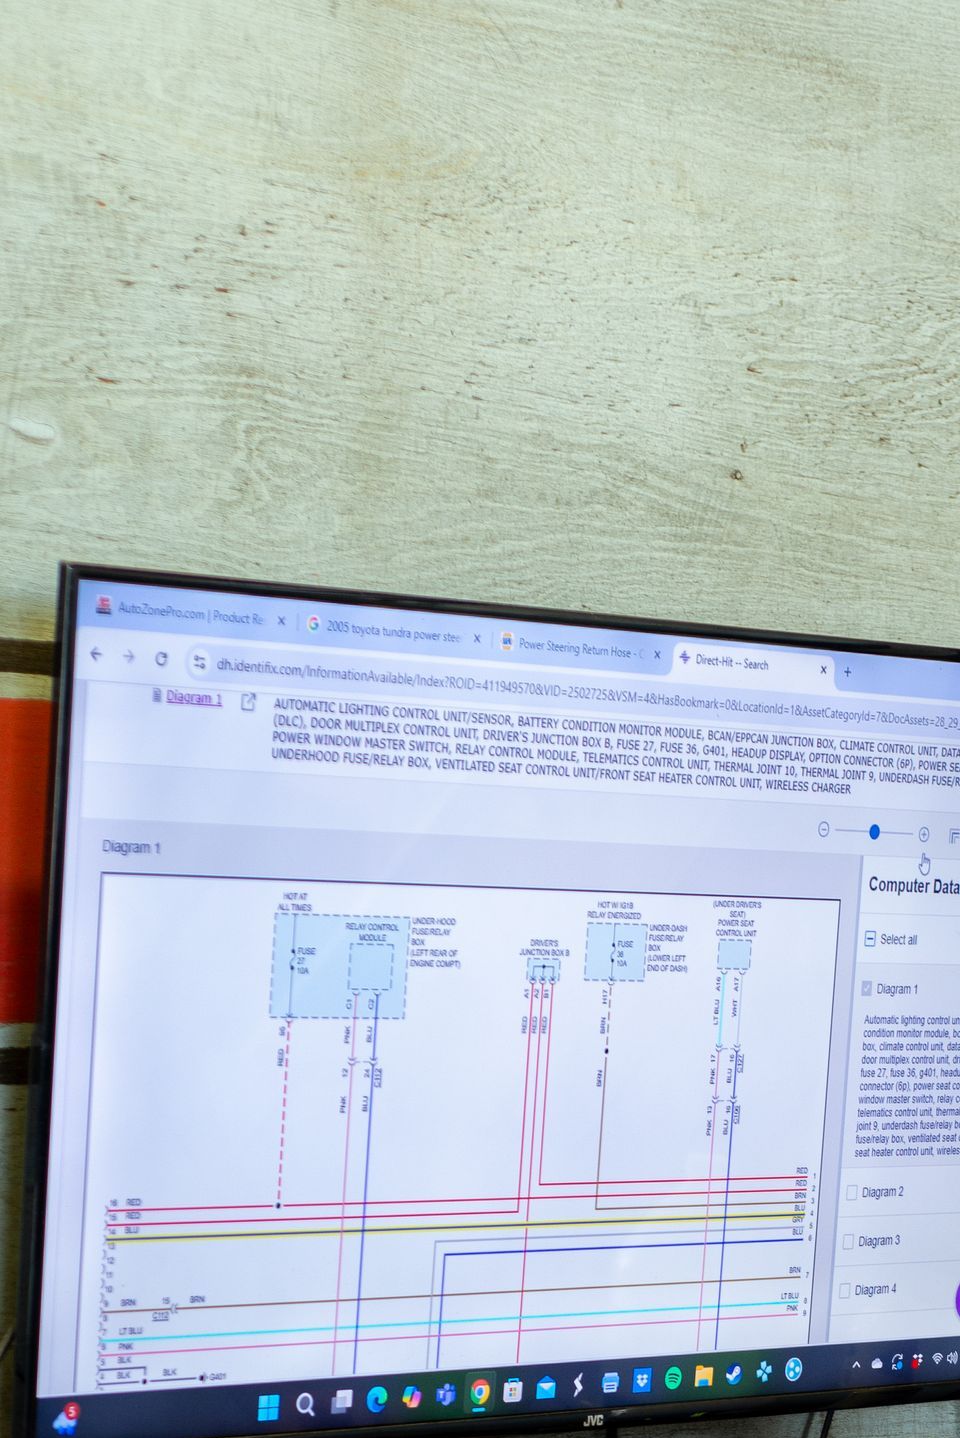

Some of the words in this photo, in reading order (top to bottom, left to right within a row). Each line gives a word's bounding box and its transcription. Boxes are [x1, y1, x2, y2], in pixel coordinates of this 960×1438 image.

[118, 602, 204, 620] AutoZonePro.com
[213, 609, 250, 624] Product
[327, 620, 349, 634] 2005
[351, 622, 380, 636] toyota
[382, 625, 411, 639] tundra
[413, 628, 440, 642] power
[519, 638, 544, 652] Power
[546, 640, 580, 655] Steering
[582, 644, 608, 657] Return
[610, 647, 631, 658] Hose
[696, 654, 732, 668] Direct-Hit
[744, 658, 768, 671] Search
[166, 690, 212, 705] Diagram
[216, 692, 222, 706] 1
[274, 698, 335, 714] AUTOMATIC
[338, 703, 389, 718] LIGHTING
[392, 706, 440, 722] CONTROL
[443, 710, 514, 727] UNIT/SENSOR,
[517, 716, 558, 730] BATTERY
[561, 719, 616, 734] CONDITION
[618, 723, 662, 738] MONITOR
[664, 726, 704, 741] MODULE,
[707, 729, 768, 745] BCAN/EPPCAN
[770, 734, 814, 748] JUNCTION
[816, 737, 836, 750] BOX,
[839, 739, 874, 753] CLIMATE
[876, 742, 915, 756] CONTROL
[917, 745, 938, 757] UNIT,
[941, 746, 960, 759] DATA
[273, 714, 306, 729] (DLC),
[310, 717, 342, 732] DOOR
[344, 719, 400, 736] MULTIPLEX
[402, 723, 450, 739] CONTROL
[453, 727, 478, 741] UNIT,
[482, 729, 528, 744] DRIVER'S
[531, 732, 578, 748] JUNCTION
[581, 736, 601, 749] BOX
[604, 738, 613, 750] B,
[616, 738, 640, 752] FUSE
[643, 740, 656, 753] 27,
[659, 742, 683, 754] FUSE
[686, 743, 699, 756] 36,
[702, 745, 728, 758] G401,
[731, 747, 767, 760] HEADUP
[769, 749, 806, 763] DISPLAY,
[808, 752, 841, 765] OPTION
[843, 755, 894, 769] CONNECTOR
[896, 758, 915, 770] (6P),
[918, 760, 947, 772] POWER
[272, 731, 310, 746] POWER
[313, 734, 361, 749] WINDOW
[364, 737, 405, 752] MASTER
[408, 740, 451, 755] SWITCH,
[455, 743, 485, 757] RELAY
[488, 746, 534, 760] CONTROL
[536, 749, 579, 763] MODULE,
[582, 752, 639, 767] TELEMATICS
[641, 756, 684, 770] CONTROL
[687, 759, 710, 772] UNIT,
[713, 761, 754, 775] THERMAL
[756, 764, 782, 777] JOINT
[785, 766, 797, 778] 10,
[800, 766, 839, 780] THERMAL
[841, 769, 866, 782] JOINT
[868, 771, 876, 783] 9,
[878, 772, 929, 786] UNDERDASH
[271, 748, 339, 763] UNDERHOOD
[343, 752, 404, 767] FUSE/RELAY
[407, 756, 431, 769] BOX,
[435, 758, 495, 773] VENTILATED
[498, 762, 522, 774] SEAT
[525, 764, 570, 778] CONTROL
[572, 766, 630, 781] UNIT/FRONT
[633, 770, 656, 783] SEAT
[658, 772, 693, 785] HEATER
[695, 774, 737, 788] CONTROL
[739, 777, 762, 789] UNIT,
[765, 779, 809, 792] WIRELESS
[811, 782, 851, 795] CHARGER
[102, 840, 150, 856] Diagram
[155, 842, 160, 854] 1
[868, 876, 930, 896] Computer
[932, 878, 960, 896] Data
[880, 933, 906, 945] Select
[907, 934, 917, 946] all
[876, 982, 911, 996] Diagram
[913, 984, 918, 996] 1
[863, 1014, 899, 1026] Automatic
[900, 1015, 925, 1026] lighting
[926, 1015, 950, 1027] control
[862, 1028, 895, 1039] condition
[896, 1028, 922, 1039] monitor
[923, 1028, 950, 1039] module,
[861, 1186, 896, 1199] Diagram
[898, 1186, 904, 1198] 2
[858, 1235, 893, 1248] Diagram
[894, 1234, 900, 1247] 3
[854, 1283, 889, 1297] Diagram
[890, 1283, 896, 1295] 4
[68, 1406, 76, 1417] 5
[583, 1414, 604, 1427] JVC
